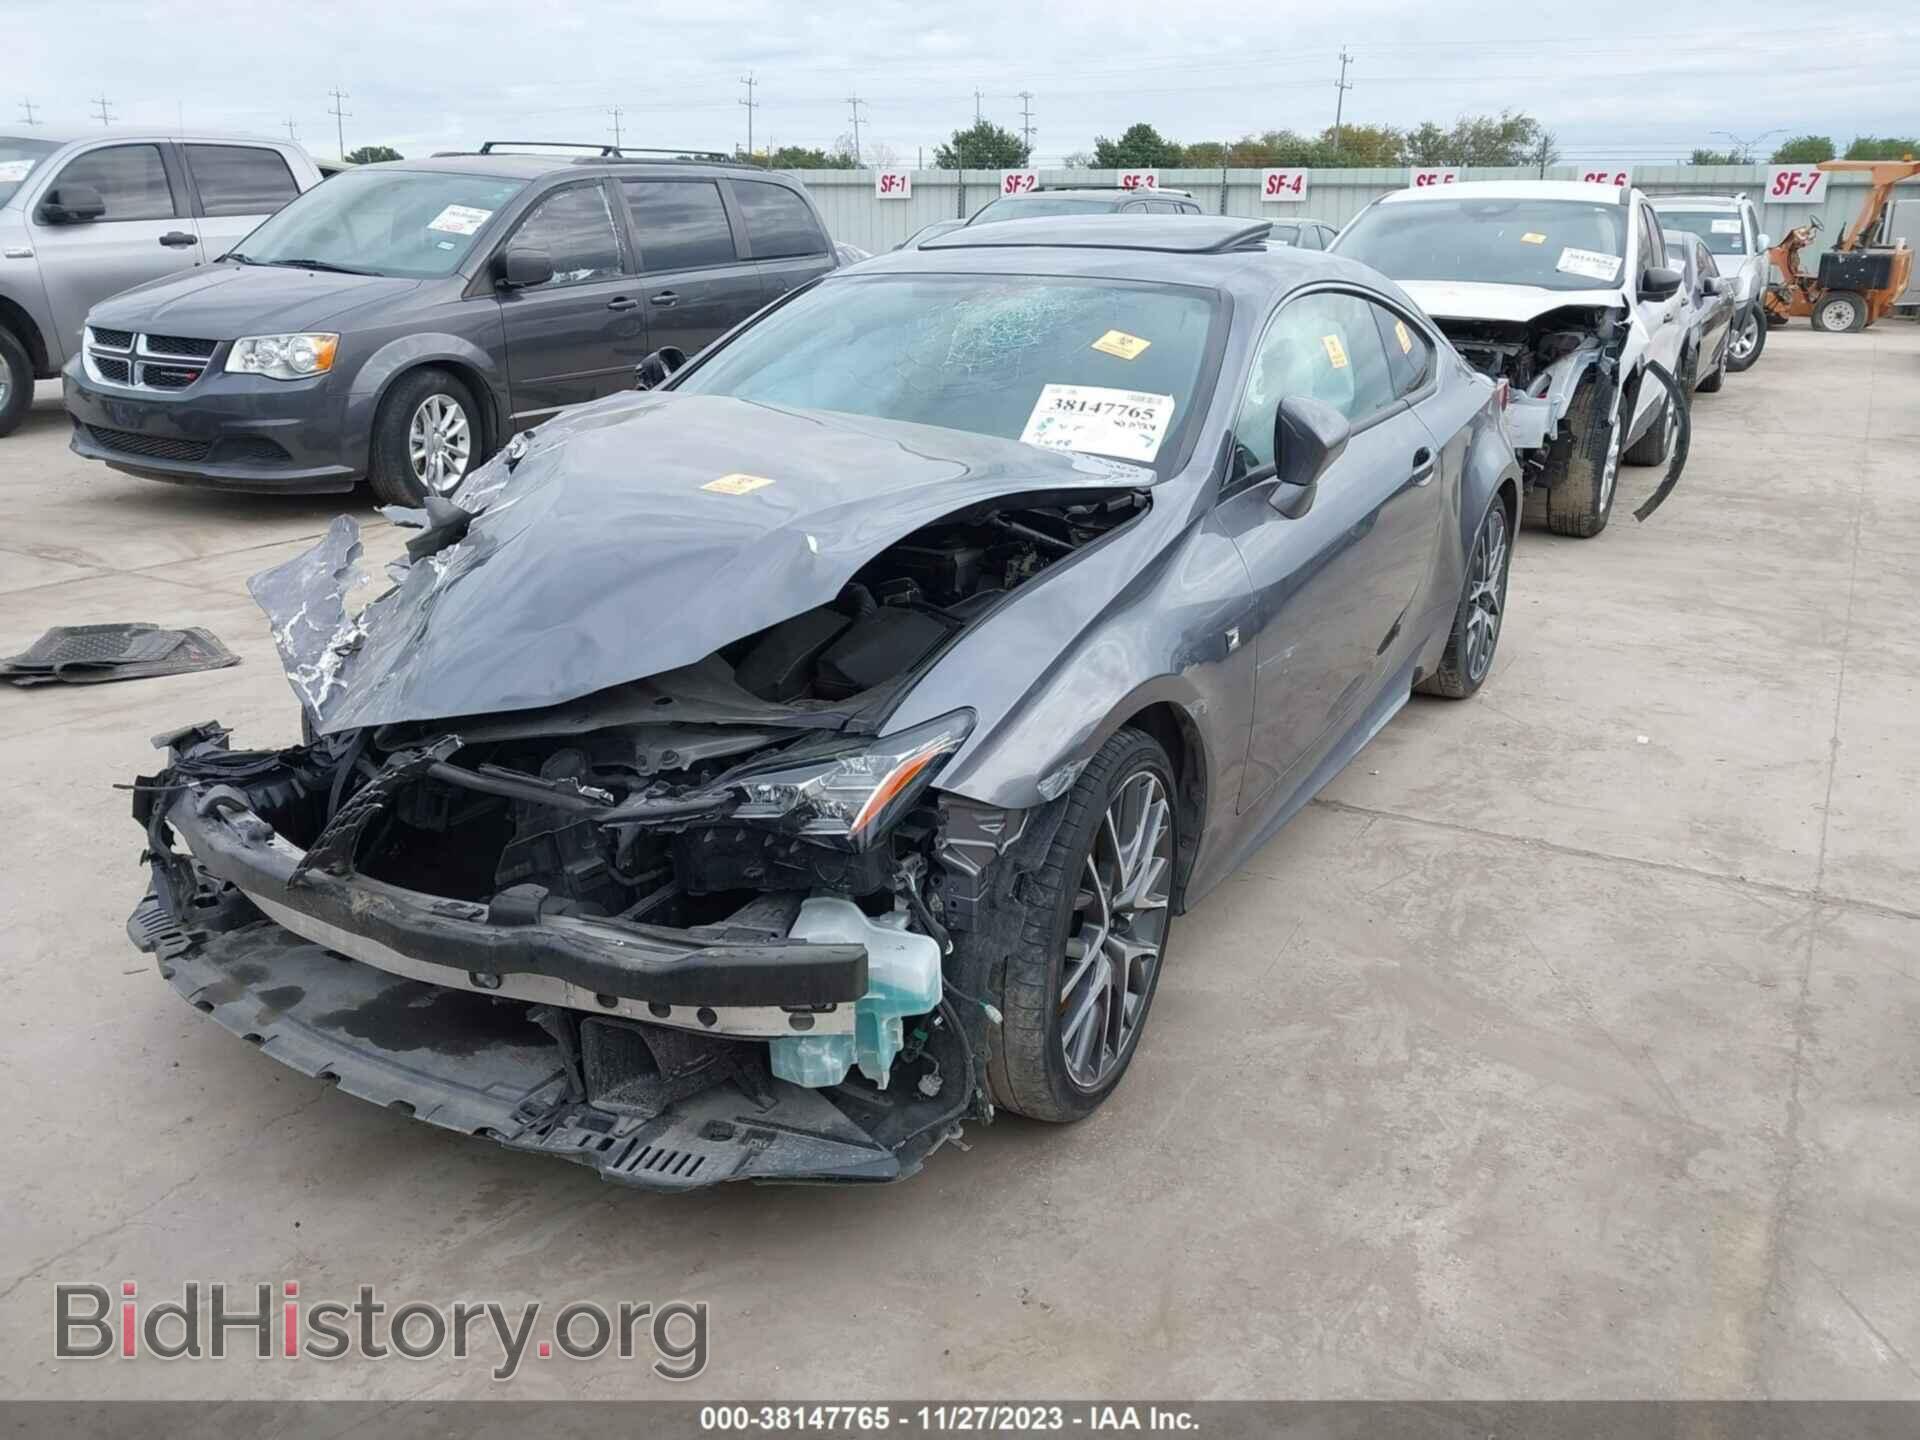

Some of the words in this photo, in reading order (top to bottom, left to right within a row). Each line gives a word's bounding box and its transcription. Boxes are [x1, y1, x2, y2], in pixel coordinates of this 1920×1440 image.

[880, 174, 906, 193] SF-1
[1005, 174, 1035, 193] SF-2
[1266, 174, 1303, 195] SF-4
[1416, 174, 1455, 186] SF5
[1772, 172, 1822, 195] SF-7
[1049, 398, 1156, 420] 38147765
